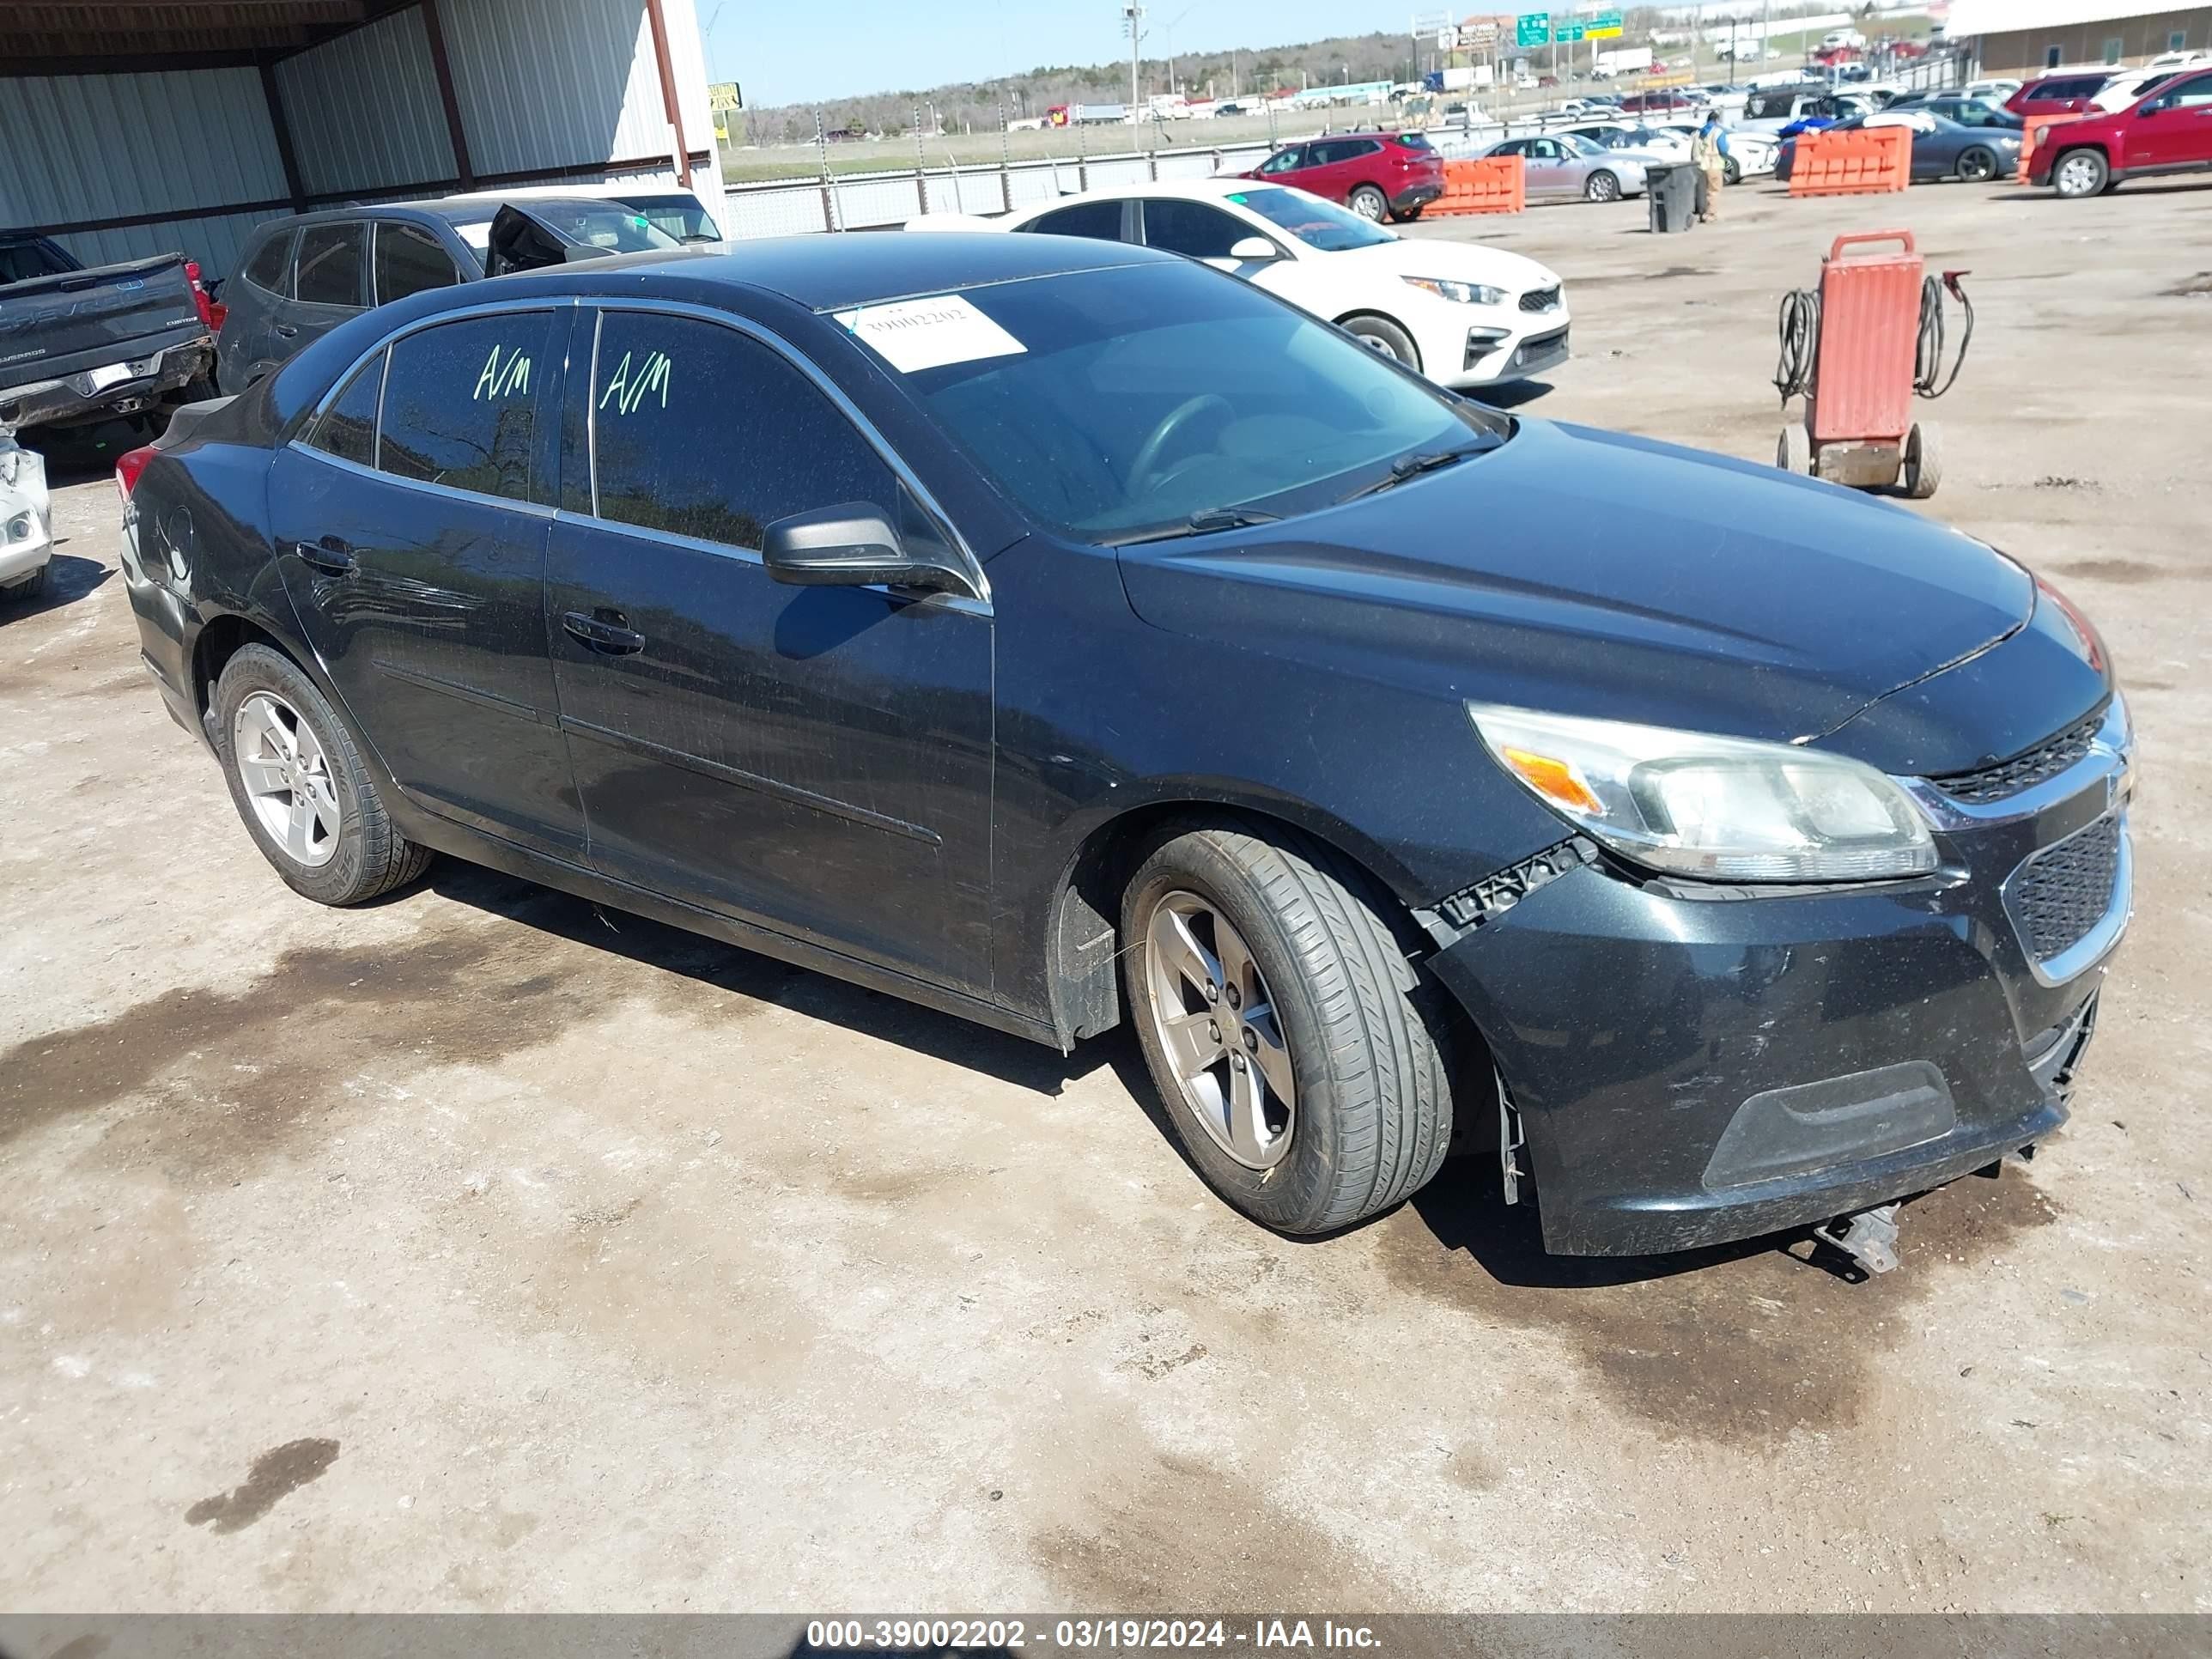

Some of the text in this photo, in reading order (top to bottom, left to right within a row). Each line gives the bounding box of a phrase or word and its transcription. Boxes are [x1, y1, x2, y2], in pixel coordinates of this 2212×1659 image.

[865, 308, 968, 332] 39002202
[473, 343, 531, 401] A/M
[599, 350, 672, 416] A/M
